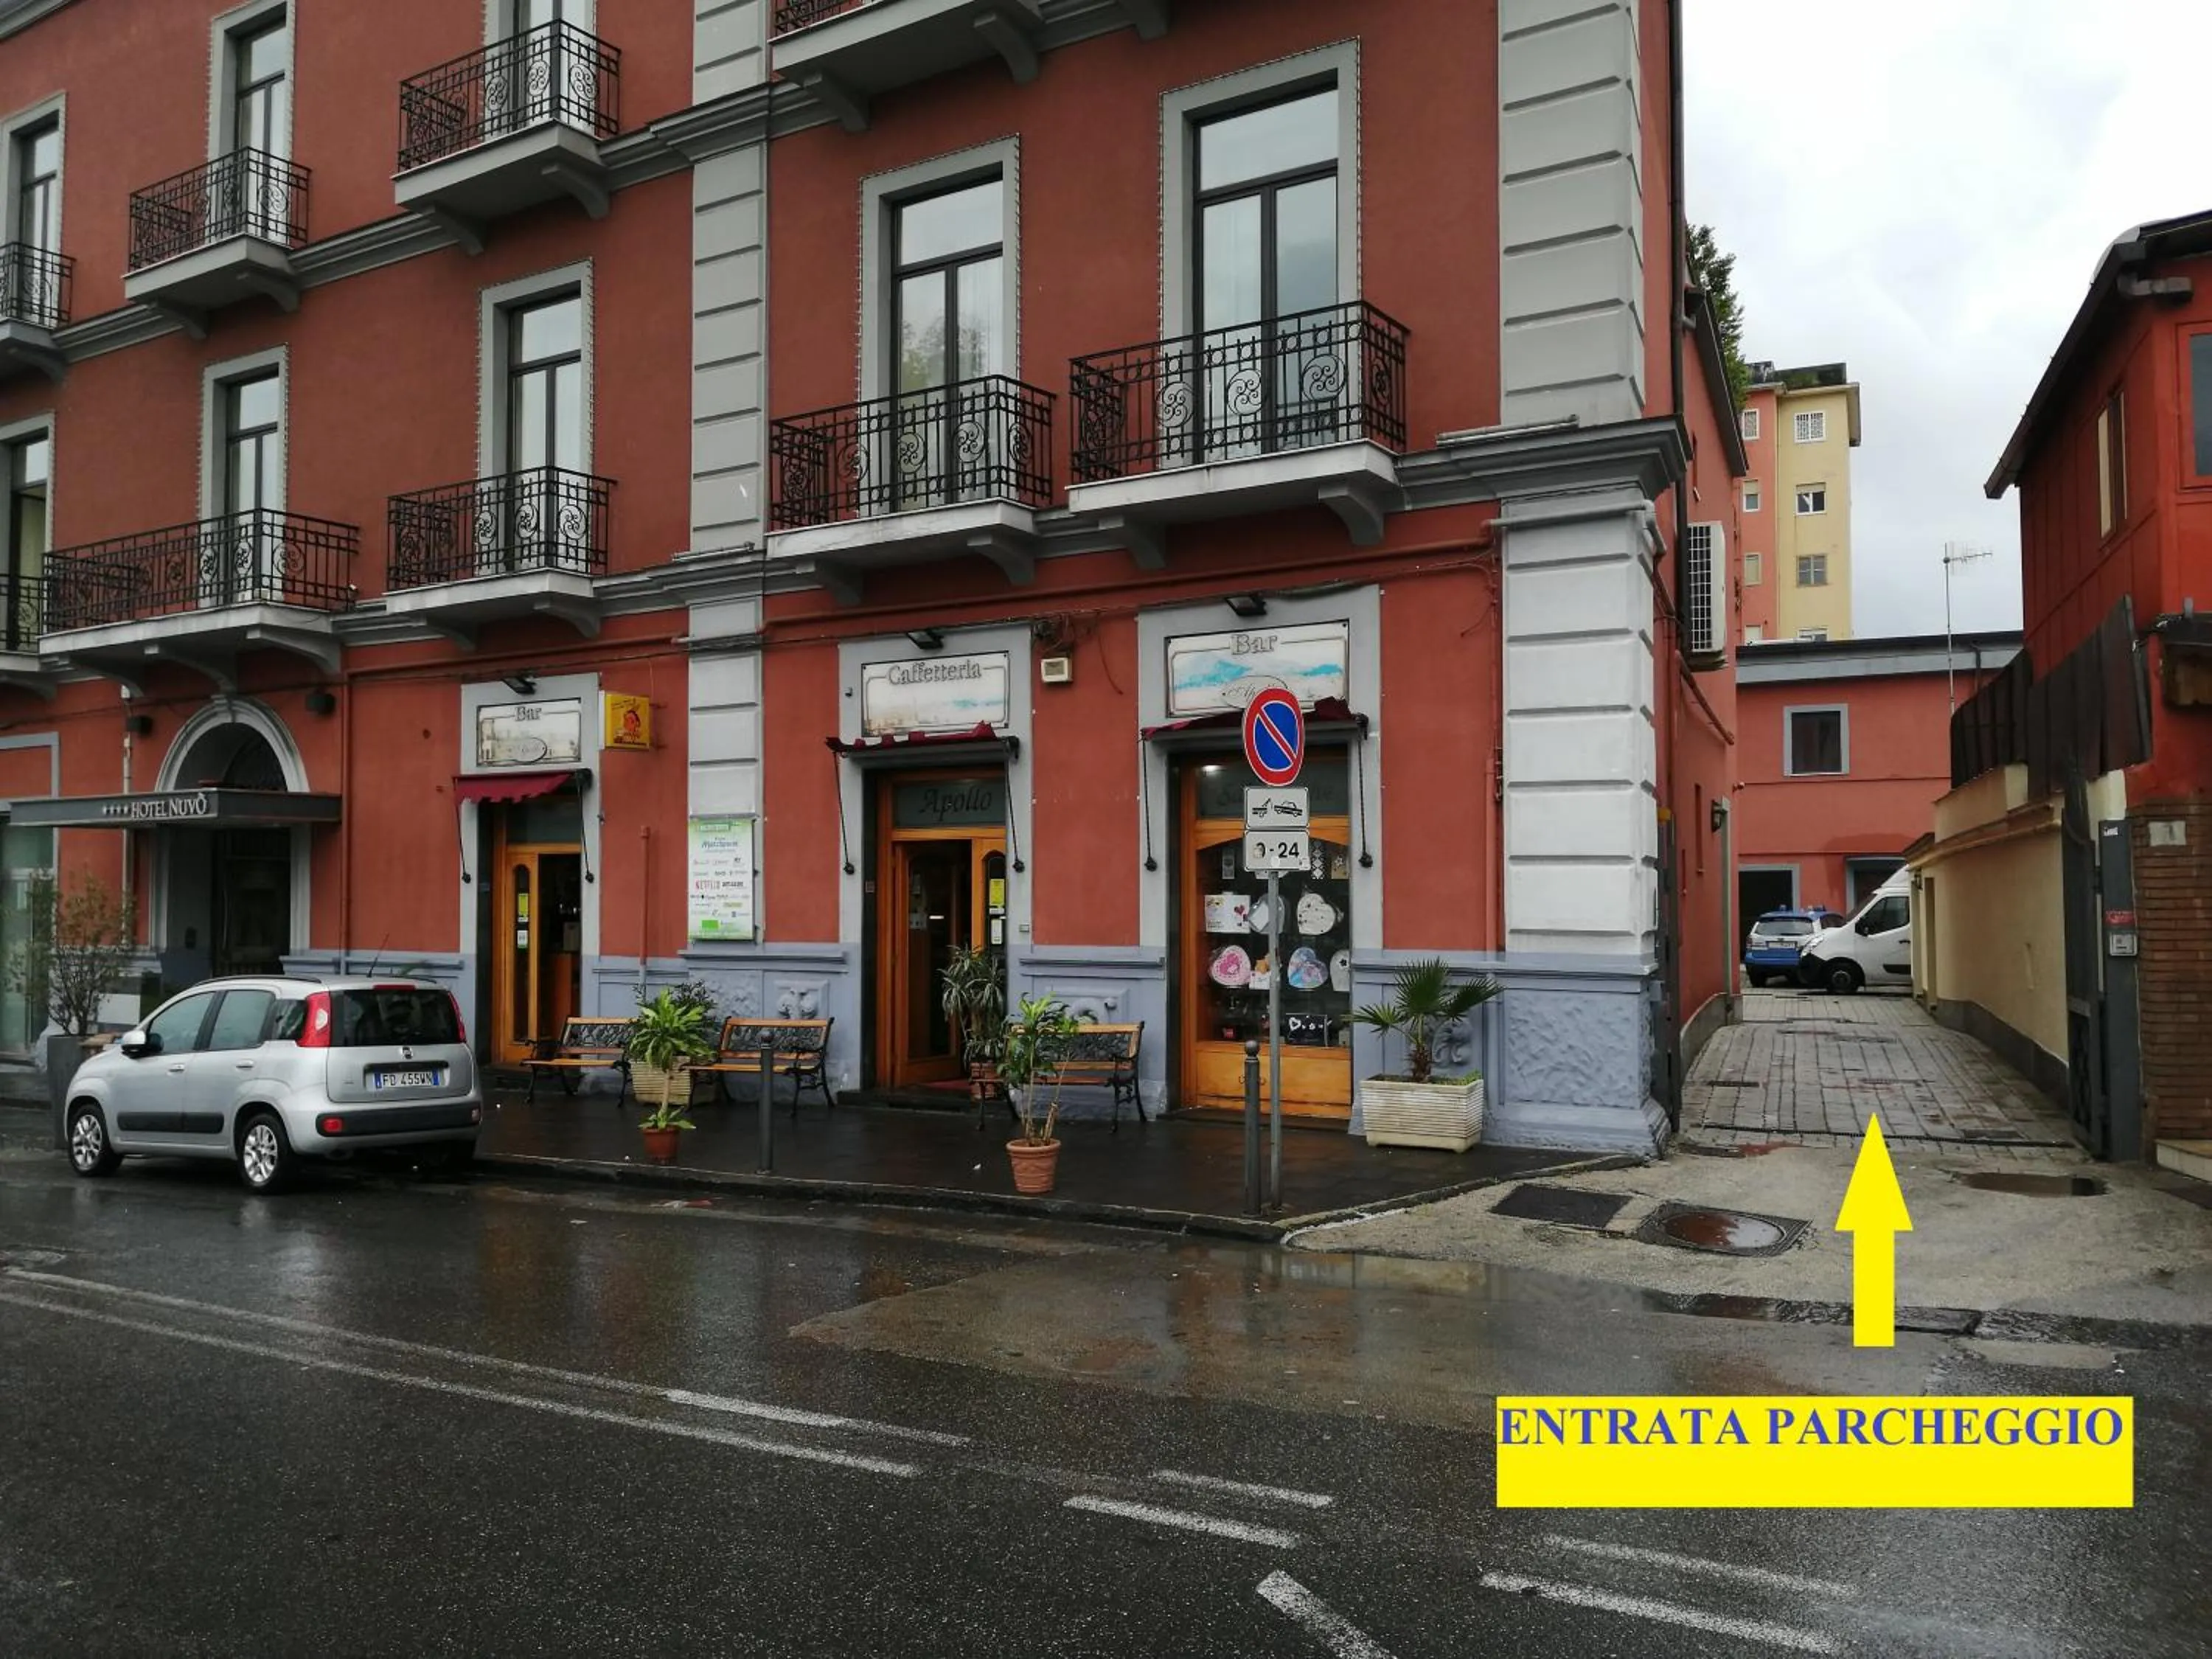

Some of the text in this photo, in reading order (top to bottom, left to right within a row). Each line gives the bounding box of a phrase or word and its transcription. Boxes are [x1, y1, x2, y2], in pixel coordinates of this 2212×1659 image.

[1231, 634, 1278, 655] Bar
[888, 659, 982, 685] Caffetteria
[515, 706, 542, 722] Bar
[131, 801, 167, 818] HOTEL
[919, 785, 992, 821] Apollo
